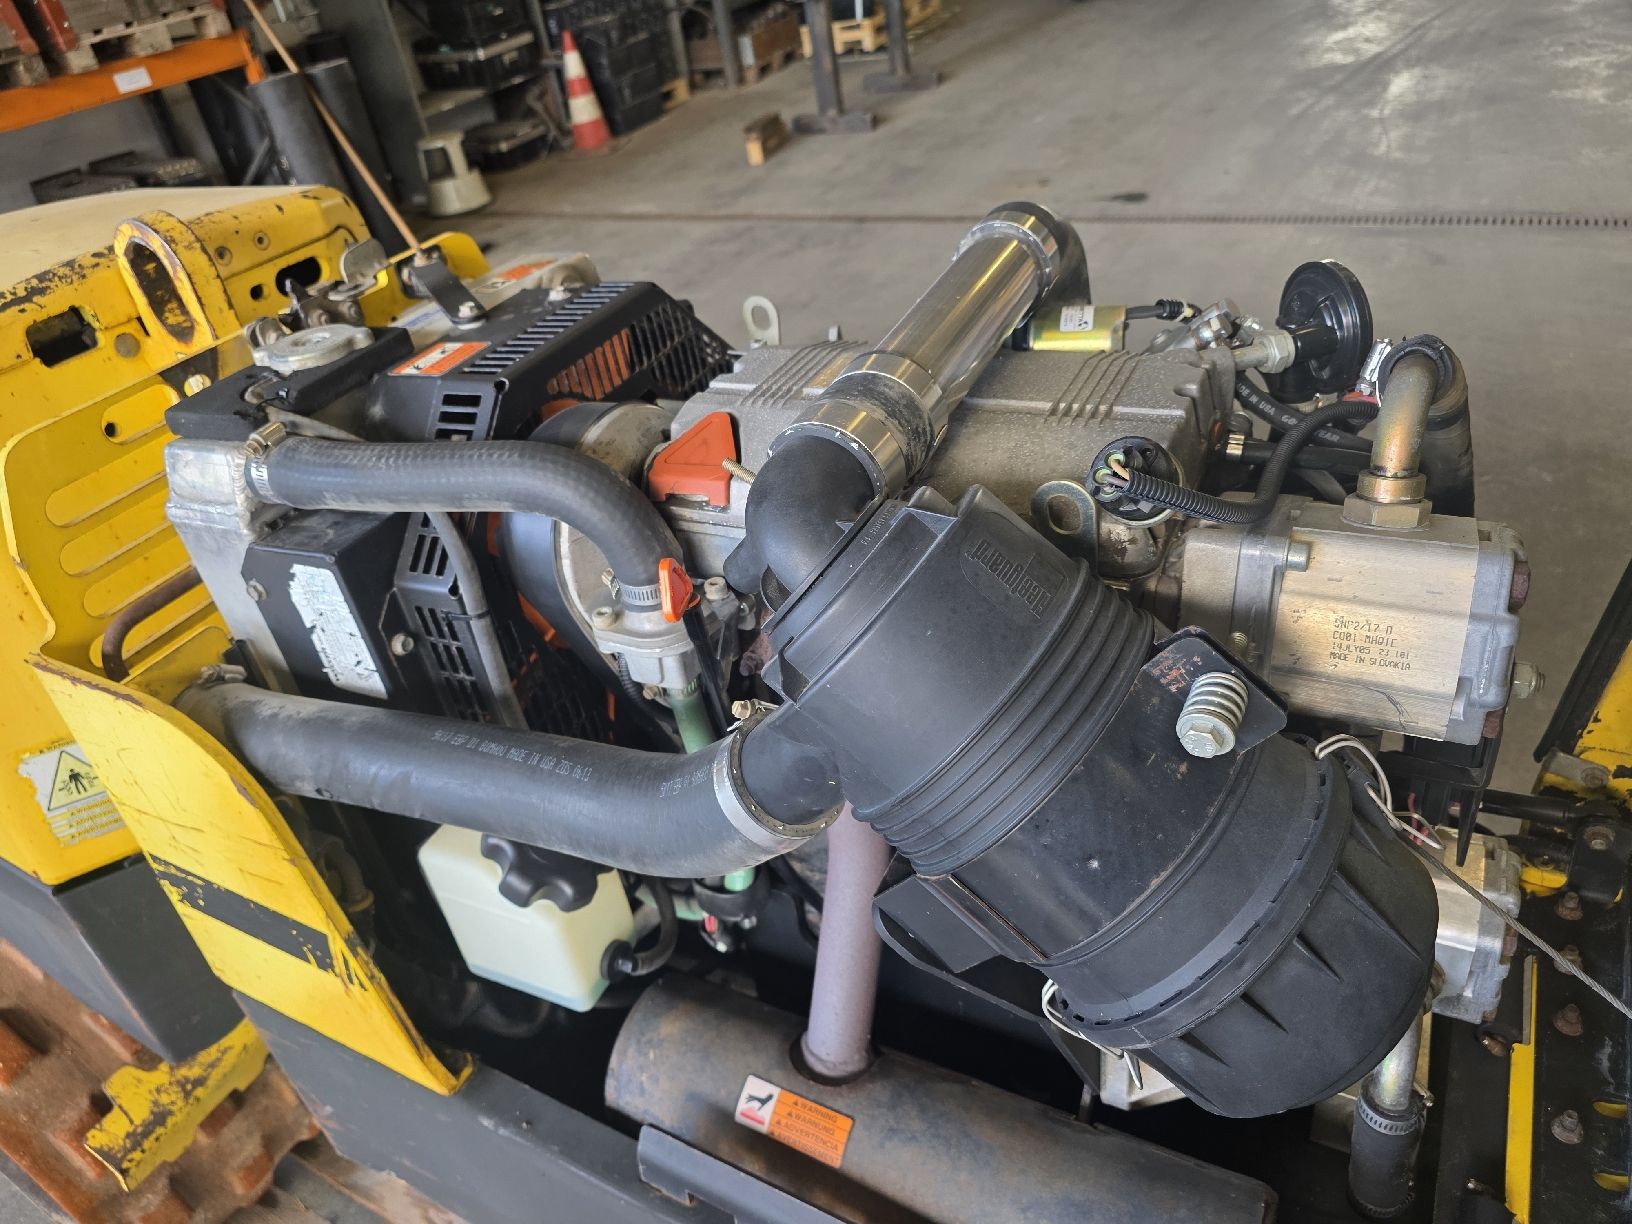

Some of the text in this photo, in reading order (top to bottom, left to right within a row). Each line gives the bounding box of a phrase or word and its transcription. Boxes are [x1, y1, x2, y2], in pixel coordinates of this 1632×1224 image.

[1258, 401, 1276, 416] USA
[1329, 651, 1411, 671] MADE IN SLOVAKIA
[506, 746, 529, 762] MADE
[528, 752, 542, 766] IN
[539, 755, 557, 770] USA
[800, 1101, 838, 1124] WARNING
[794, 1113, 836, 1136] WARNUNG
